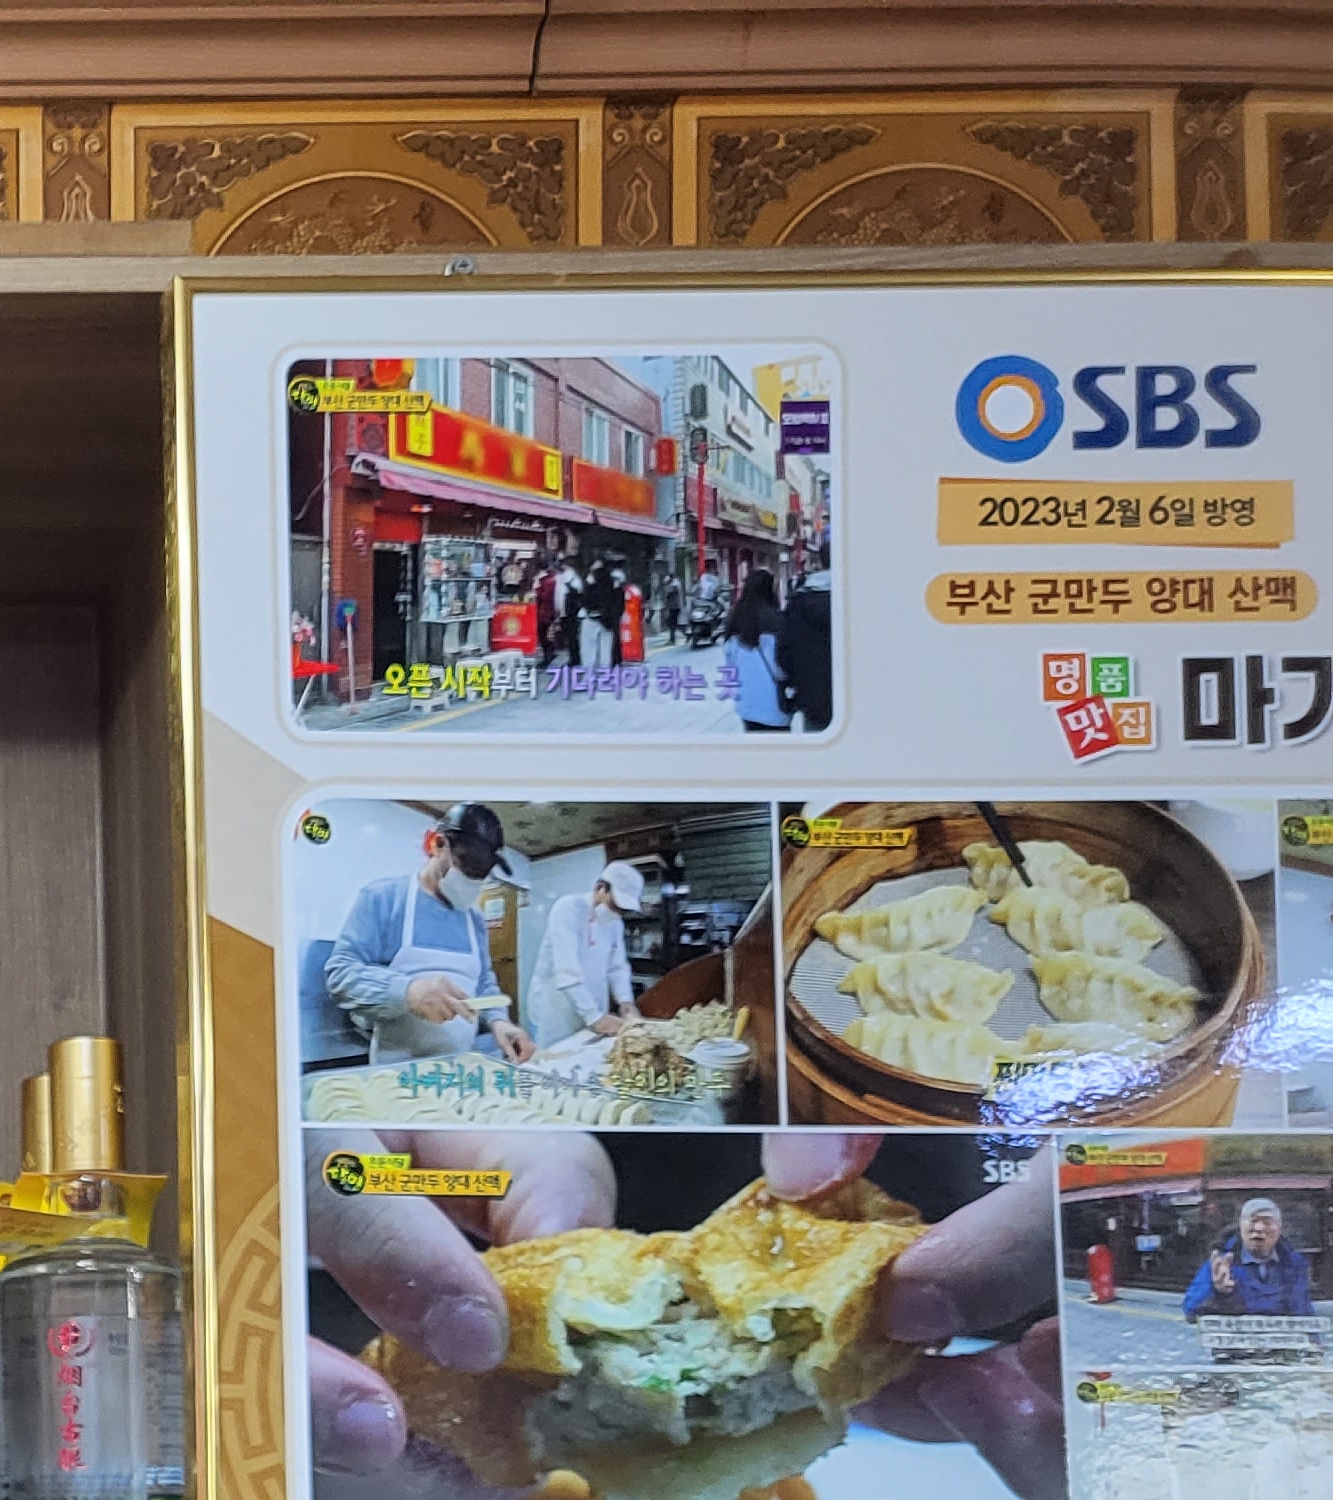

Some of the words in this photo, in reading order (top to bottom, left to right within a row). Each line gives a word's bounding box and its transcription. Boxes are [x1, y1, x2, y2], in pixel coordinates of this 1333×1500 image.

[1071, 364, 1263, 451] SBS
[978, 496, 1087, 528] 2023년
[1095, 496, 1141, 528] 2월
[1149, 495, 1195, 527] 6일
[1203, 496, 1256, 527] 방영
[946, 579, 1016, 616] 부산
[1027, 578, 1132, 615] 군만두
[1145, 576, 1215, 614] 양대
[1228, 575, 1297, 612] 산맥
[383, 663, 432, 699] 오픈
[440, 664, 538, 700] 시작부터
[545, 666, 650, 700] 기다려야
[655, 667, 706, 700] 하는
[712, 666, 741, 701] 곳
[368, 1174, 396, 1192] 부산
[399, 1174, 439, 1192] 군만두
[444, 1174, 470, 1192] 양대
[473, 1175, 501, 1192] 산맥
[982, 1160, 1031, 1183] SBS
